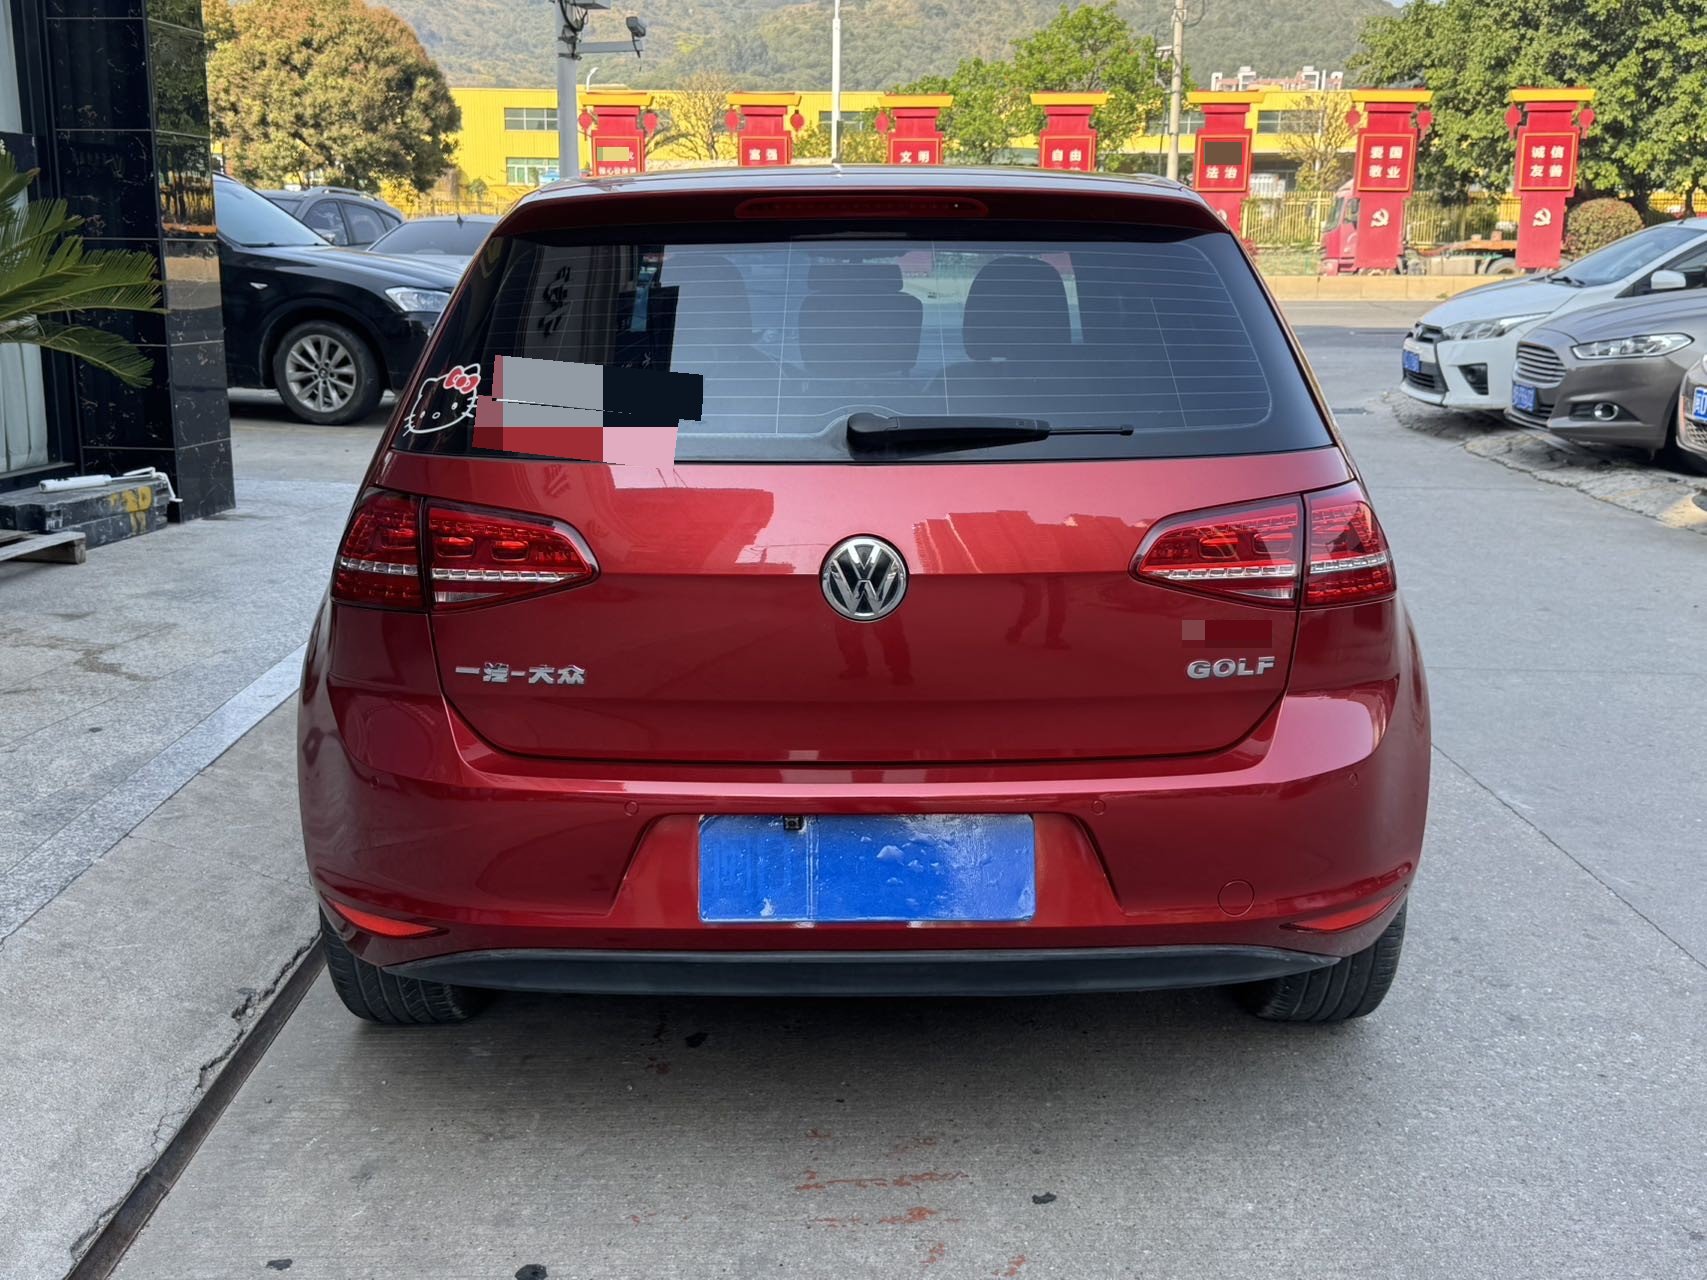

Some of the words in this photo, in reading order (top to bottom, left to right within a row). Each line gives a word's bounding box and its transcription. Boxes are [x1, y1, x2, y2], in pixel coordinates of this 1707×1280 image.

[749, 148, 778, 161] 富强
[900, 150, 930, 163] 文明
[1052, 149, 1082, 162] 自由
[1370, 146, 1403, 160] 爱国
[1532, 146, 1565, 159] 诚信
[1206, 166, 1238, 179] 法治
[1369, 165, 1402, 179] 敬业
[1530, 164, 1564, 178] 友善
[1186, 655, 1275, 679] GOLF
